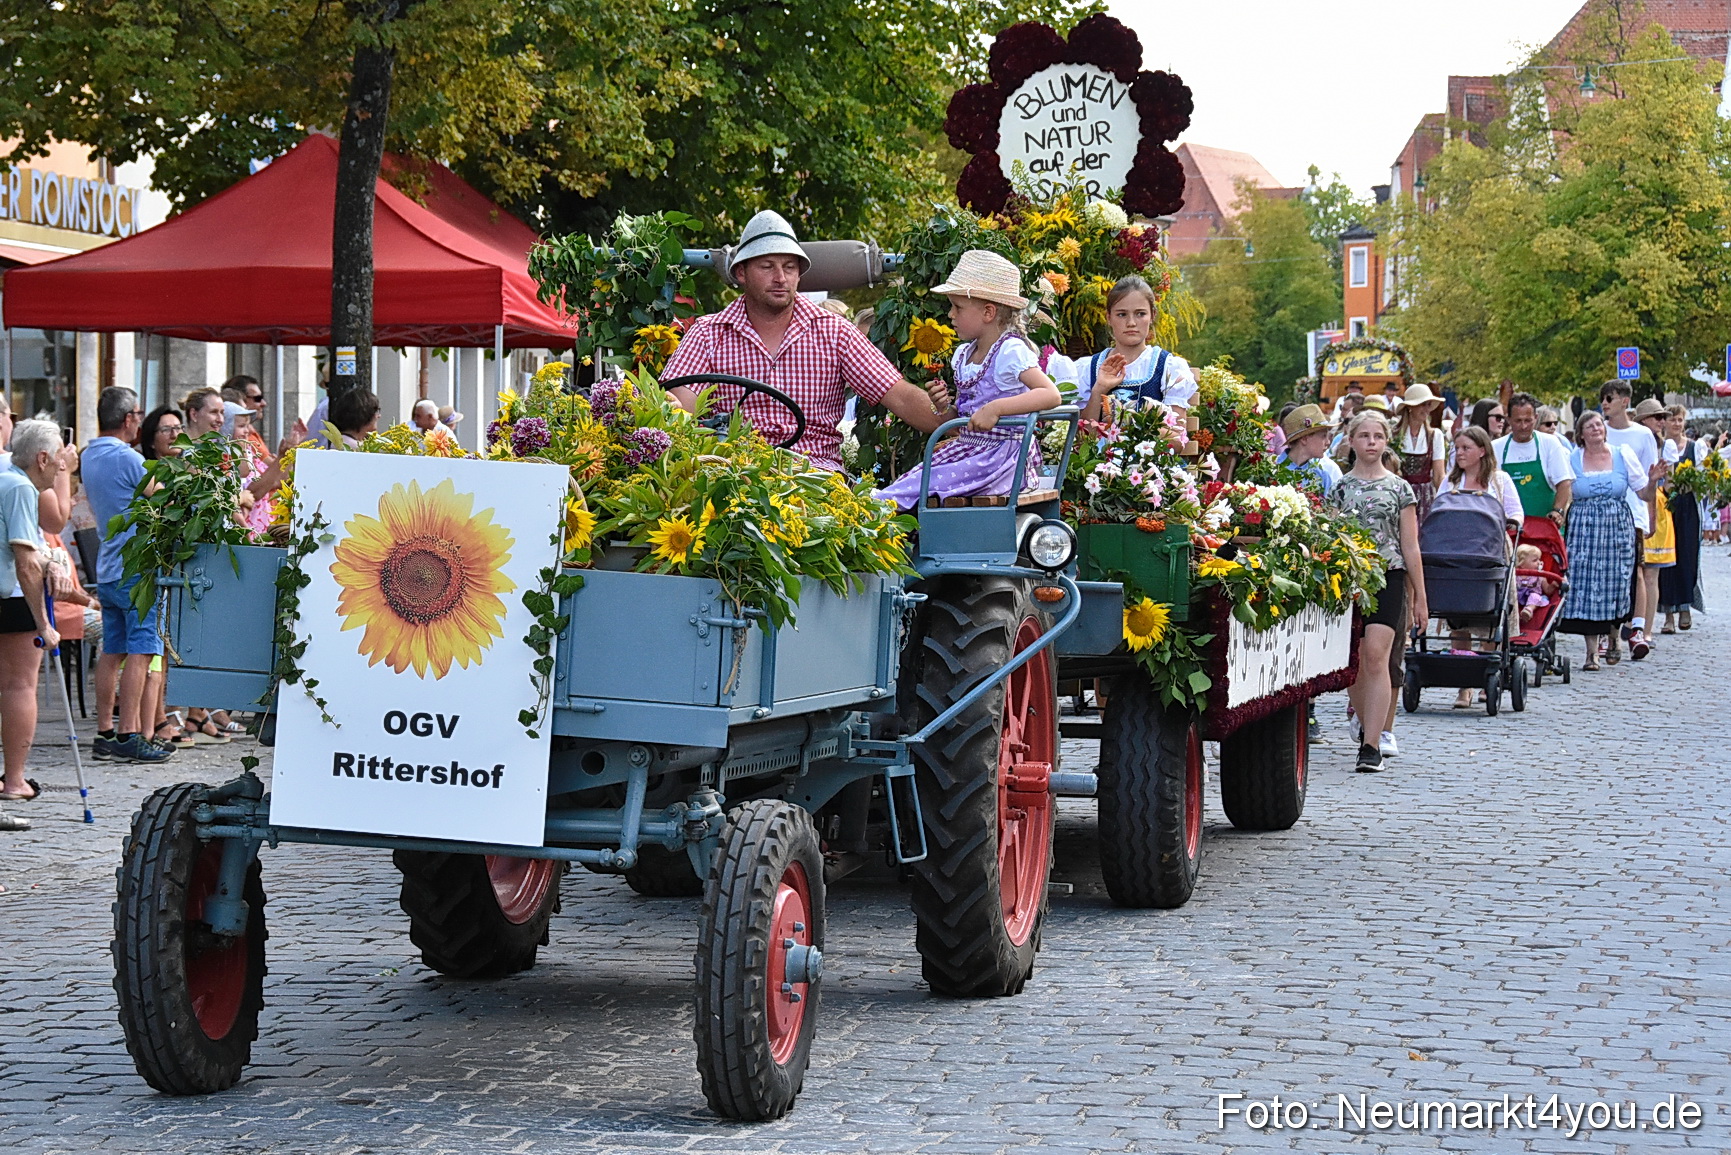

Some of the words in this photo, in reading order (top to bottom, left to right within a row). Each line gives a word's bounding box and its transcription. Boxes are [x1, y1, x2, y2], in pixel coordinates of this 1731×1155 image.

[1014, 72, 1127, 119] BLUMEN
[1052, 101, 1087, 123] und
[1024, 121, 1112, 153] NATUR
[1029, 151, 1064, 176] auf
[1072, 148, 1110, 171] der
[1620, 369, 1638, 377] TAXI
[383, 710, 460, 739] OGV
[332, 752, 505, 789] Rittershof
